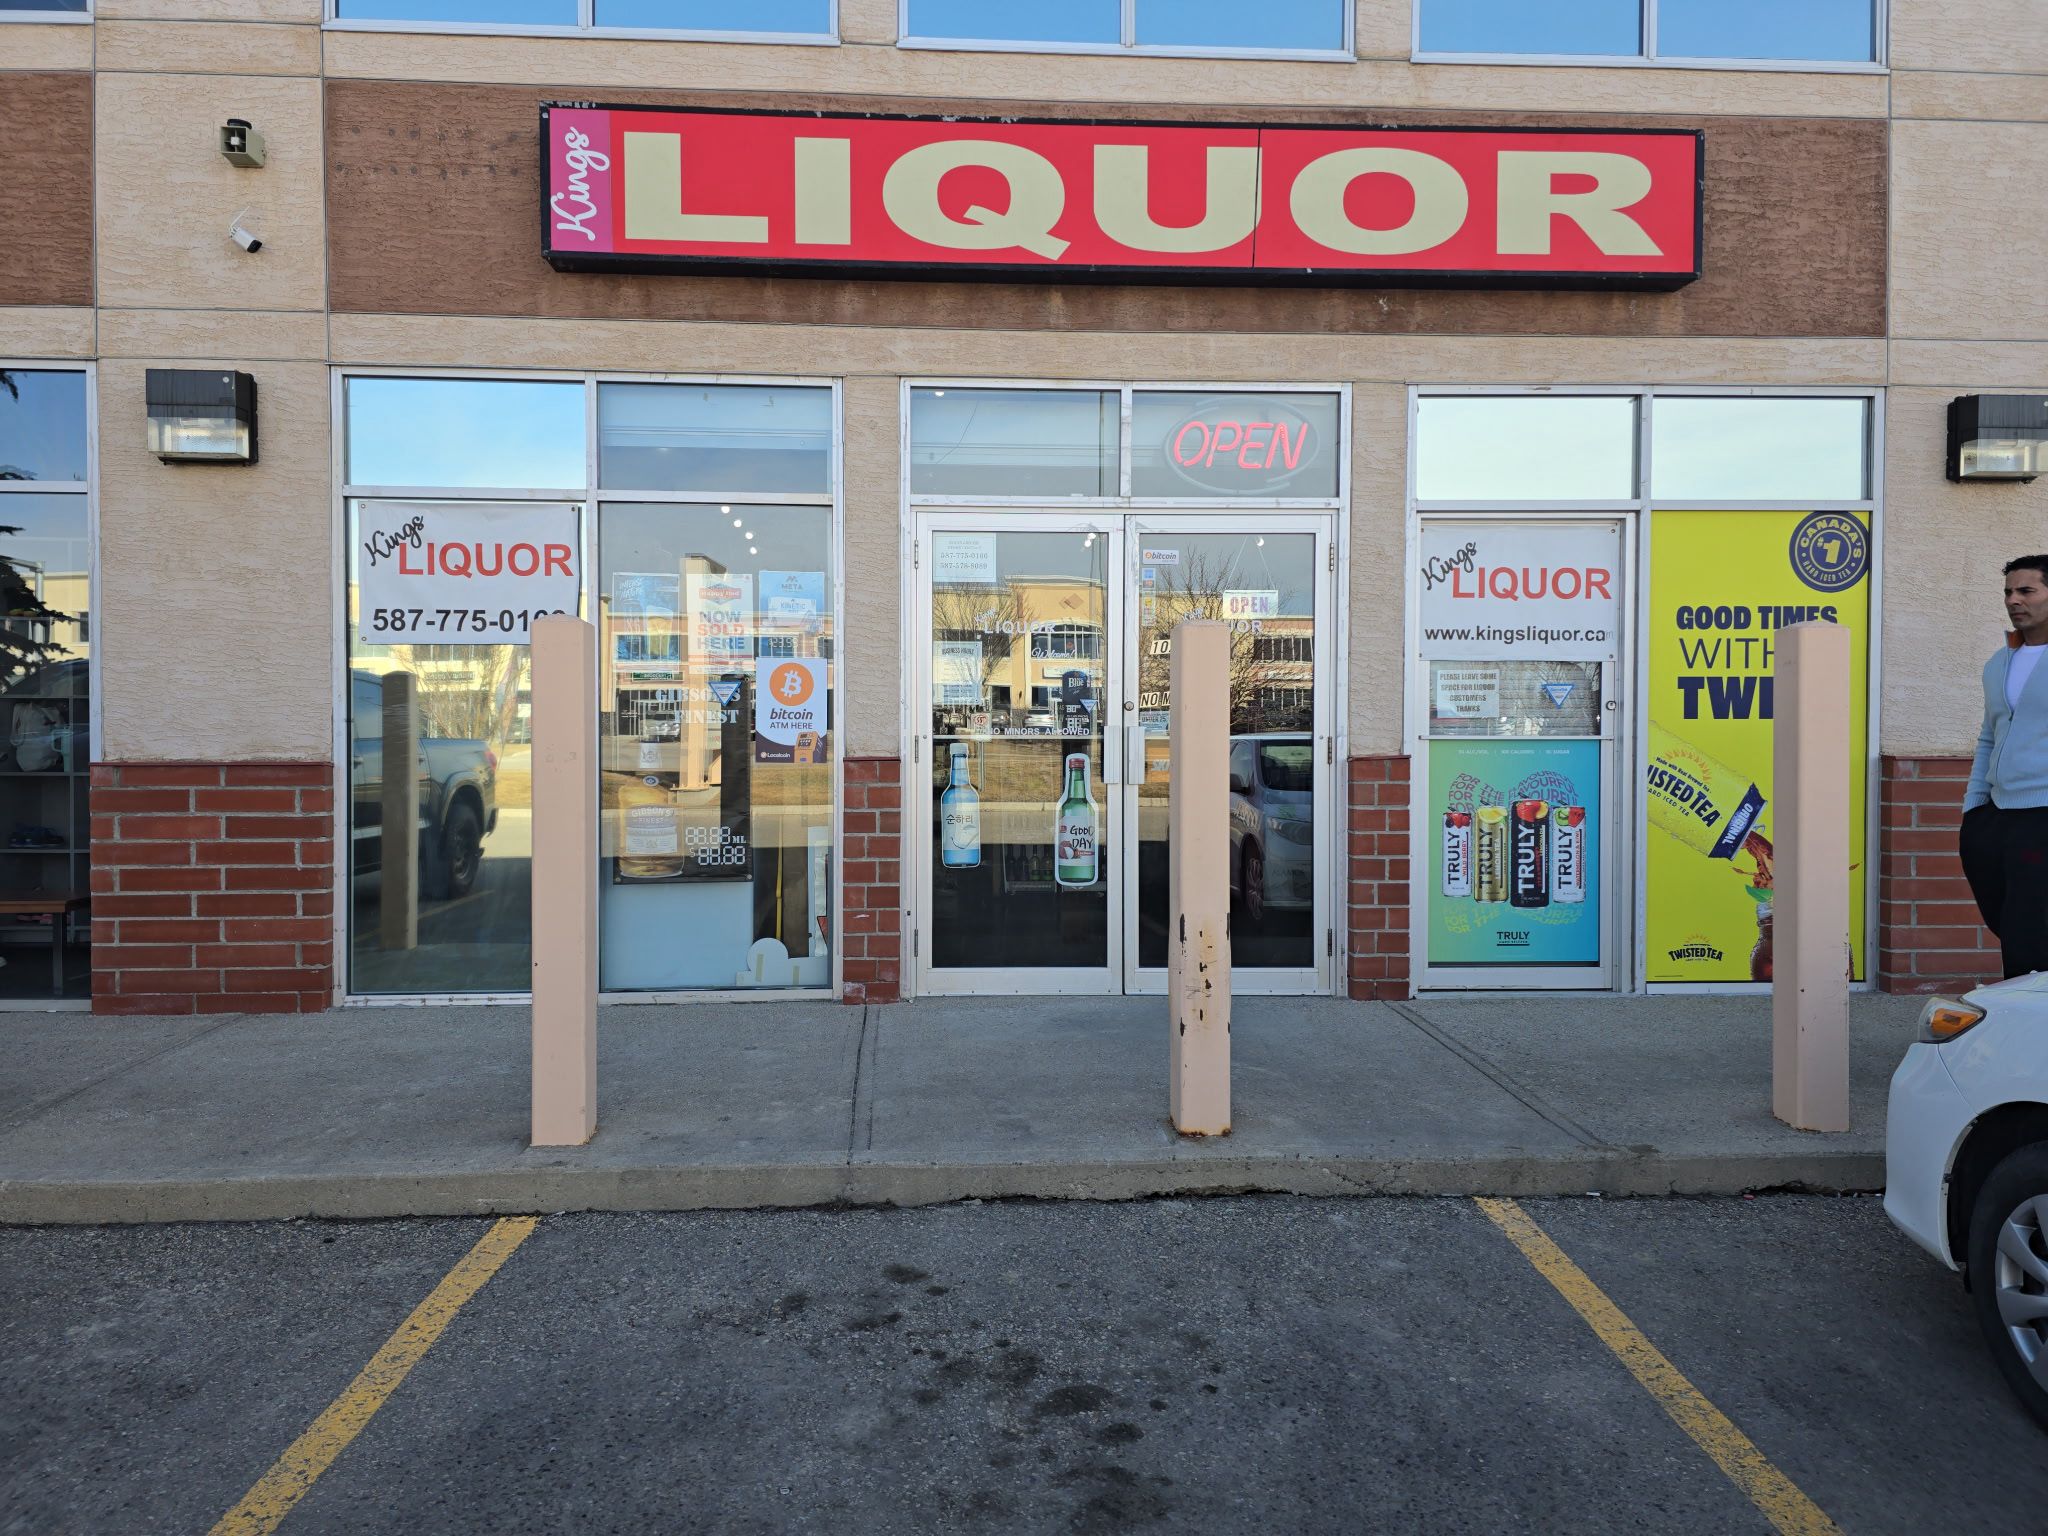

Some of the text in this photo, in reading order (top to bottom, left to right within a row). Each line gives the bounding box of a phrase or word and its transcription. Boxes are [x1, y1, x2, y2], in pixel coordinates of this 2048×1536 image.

[550, 126, 610, 241] Kings
[624, 131, 1665, 261] LIQUOR
[1174, 420, 1309, 470] OPEN
[364, 515, 425, 567] Kings
[1800, 518, 1862, 559] CANADA'S
[1151, 551, 1177, 560] bitcoin
[1816, 536, 1841, 564] #1
[399, 542, 574, 578] LIQUOR
[1421, 541, 1478, 591] Kings
[1838, 568, 1852, 580] TEA
[1452, 567, 1612, 601] LIQUOR
[1229, 596, 1270, 614] OPEN
[699, 610, 742, 623] NOW
[1676, 605, 1838, 630] GOOD TIMES
[697, 623, 745, 636] SOLD
[984, 620, 1057, 634] LIQUOR
[697, 637, 745, 650] HERE
[655, 687, 742, 702] GIBSOS
[1141, 692, 1159, 707] NO
[674, 709, 740, 724] FINEST
[769, 708, 814, 721] bitcoin
[769, 722, 813, 730] ATM HERE
[1004, 727, 1040, 736] MINORS
[1044, 727, 1090, 736] ALLOWED
[1457, 772, 1481, 786] FOR
[1450, 781, 1476, 793] FOR
[1448, 790, 1473, 802] FOR
[1647, 764, 1721, 828] ISTED TEA
[1647, 786, 1690, 817] ARD ICED TEA
[945, 814, 974, 825] 순하리
[1721, 802, 1754, 845] ORIGINAL
[732, 835, 747, 844] ML
[1071, 837, 1095, 850] DAY
[1448, 831, 1460, 885] TRULY
[1479, 827, 1493, 889] TRULY
[1518, 823, 1535, 894] TRULY
[1558, 828, 1573, 890] TRULY
[1497, 931, 1530, 940] TRULY
[1668, 946, 1724, 962] TWISTED TEA
